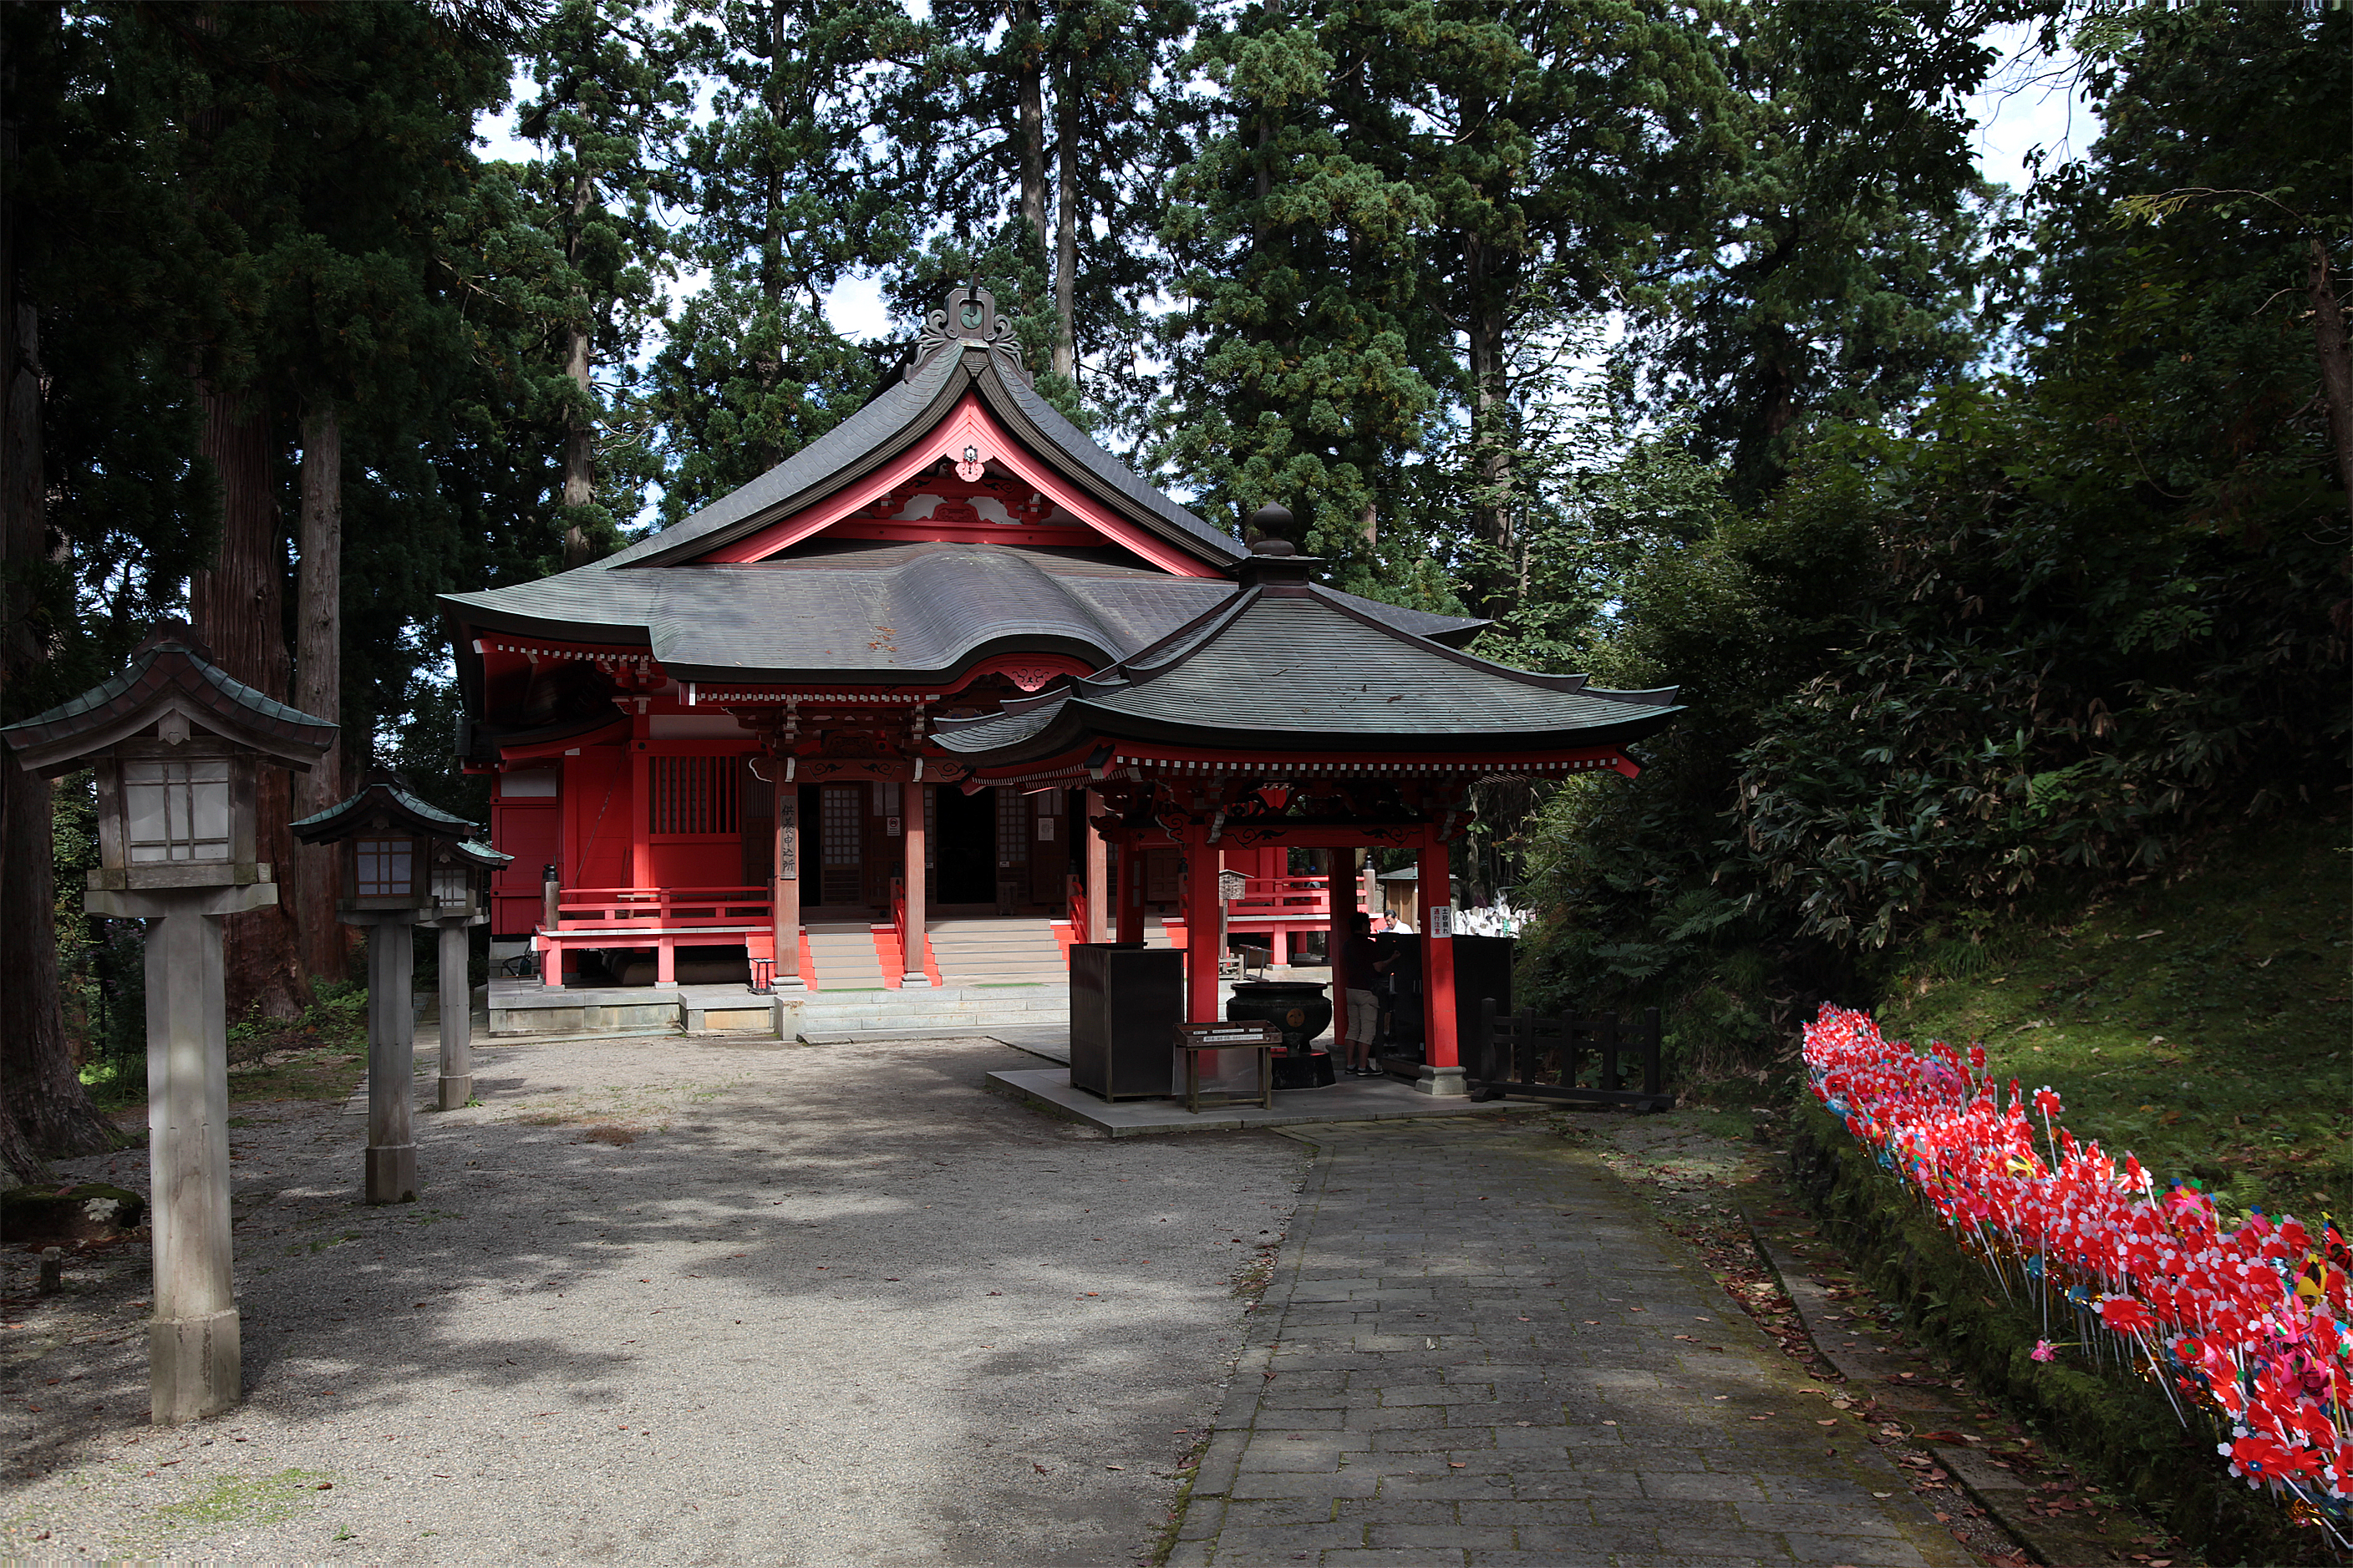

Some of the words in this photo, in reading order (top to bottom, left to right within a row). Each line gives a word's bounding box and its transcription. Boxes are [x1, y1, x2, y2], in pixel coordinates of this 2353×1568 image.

[781, 804, 795, 872] 供養申込所
